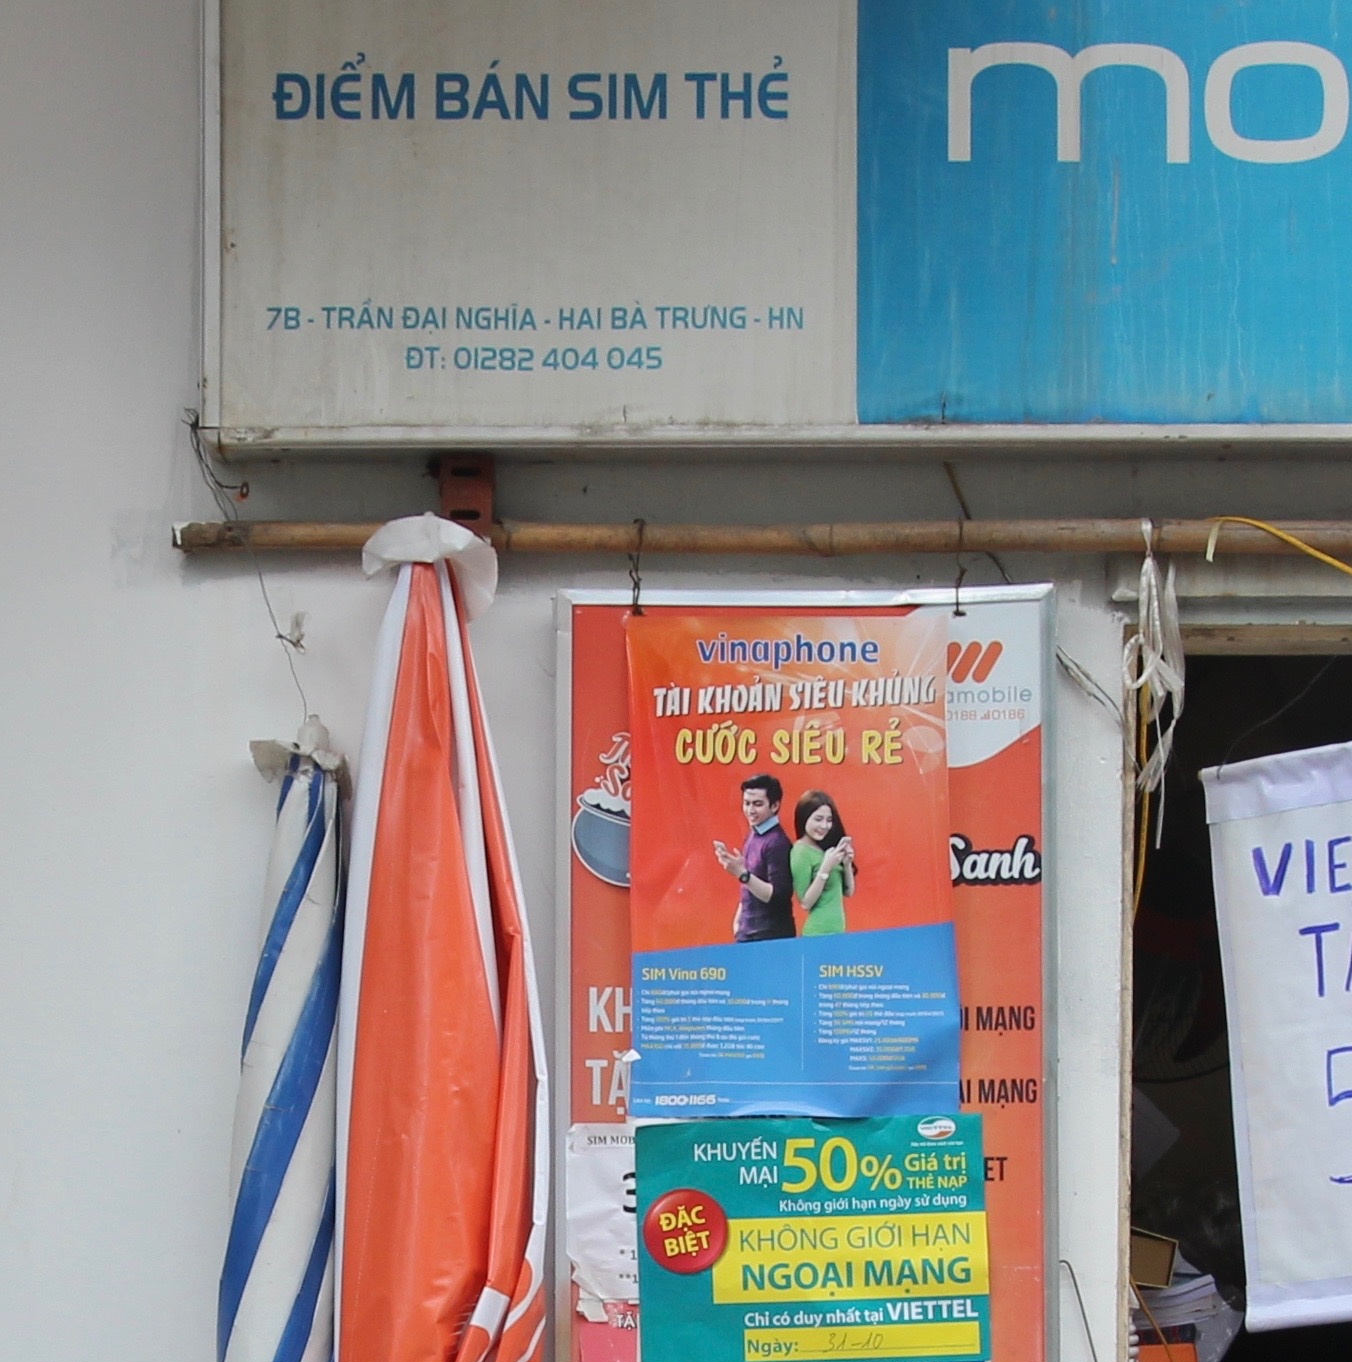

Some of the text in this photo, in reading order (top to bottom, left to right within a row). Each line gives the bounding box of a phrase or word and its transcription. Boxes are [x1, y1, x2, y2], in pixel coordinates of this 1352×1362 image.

[272, 52, 790, 120] ĐIỂM BÁN SIM THẺ
[265, 297, 805, 334] 7B TRẦN ĐẠI NGHĨA HAI BÀ TRƯNG HN
[405, 346, 663, 371] ĐT: 01282 404 045
[698, 634, 879, 669] vinaphone
[653, 669, 937, 718] TÀI KHOẢN SIÊU KHỦNG
[675, 720, 758, 765] CƯỚC
[770, 719, 845, 764] SIÊU
[862, 718, 905, 765] RẺ
[642, 968, 665, 981] SIM
[819, 965, 843, 978] SIM
[976, 1005, 1035, 1036] MẠNG
[979, 1079, 1037, 1114] MẠNG
[693, 1136, 967, 1193] KHUYẾN 50% Giá trị
[739, 1166, 968, 1192] MẠI THẺ NẠP
[659, 1205, 706, 1232] ĐẶC
[664, 1231, 711, 1257] BIỆT
[739, 1220, 971, 1252] KHÔNG GIỚI HẠN
[741, 1256, 972, 1297] NGOẠI MẠNG
[744, 1299, 979, 1328] Chỉ có duy nhất tại VIETTEL
[746, 1337, 798, 1356] Ngày:
